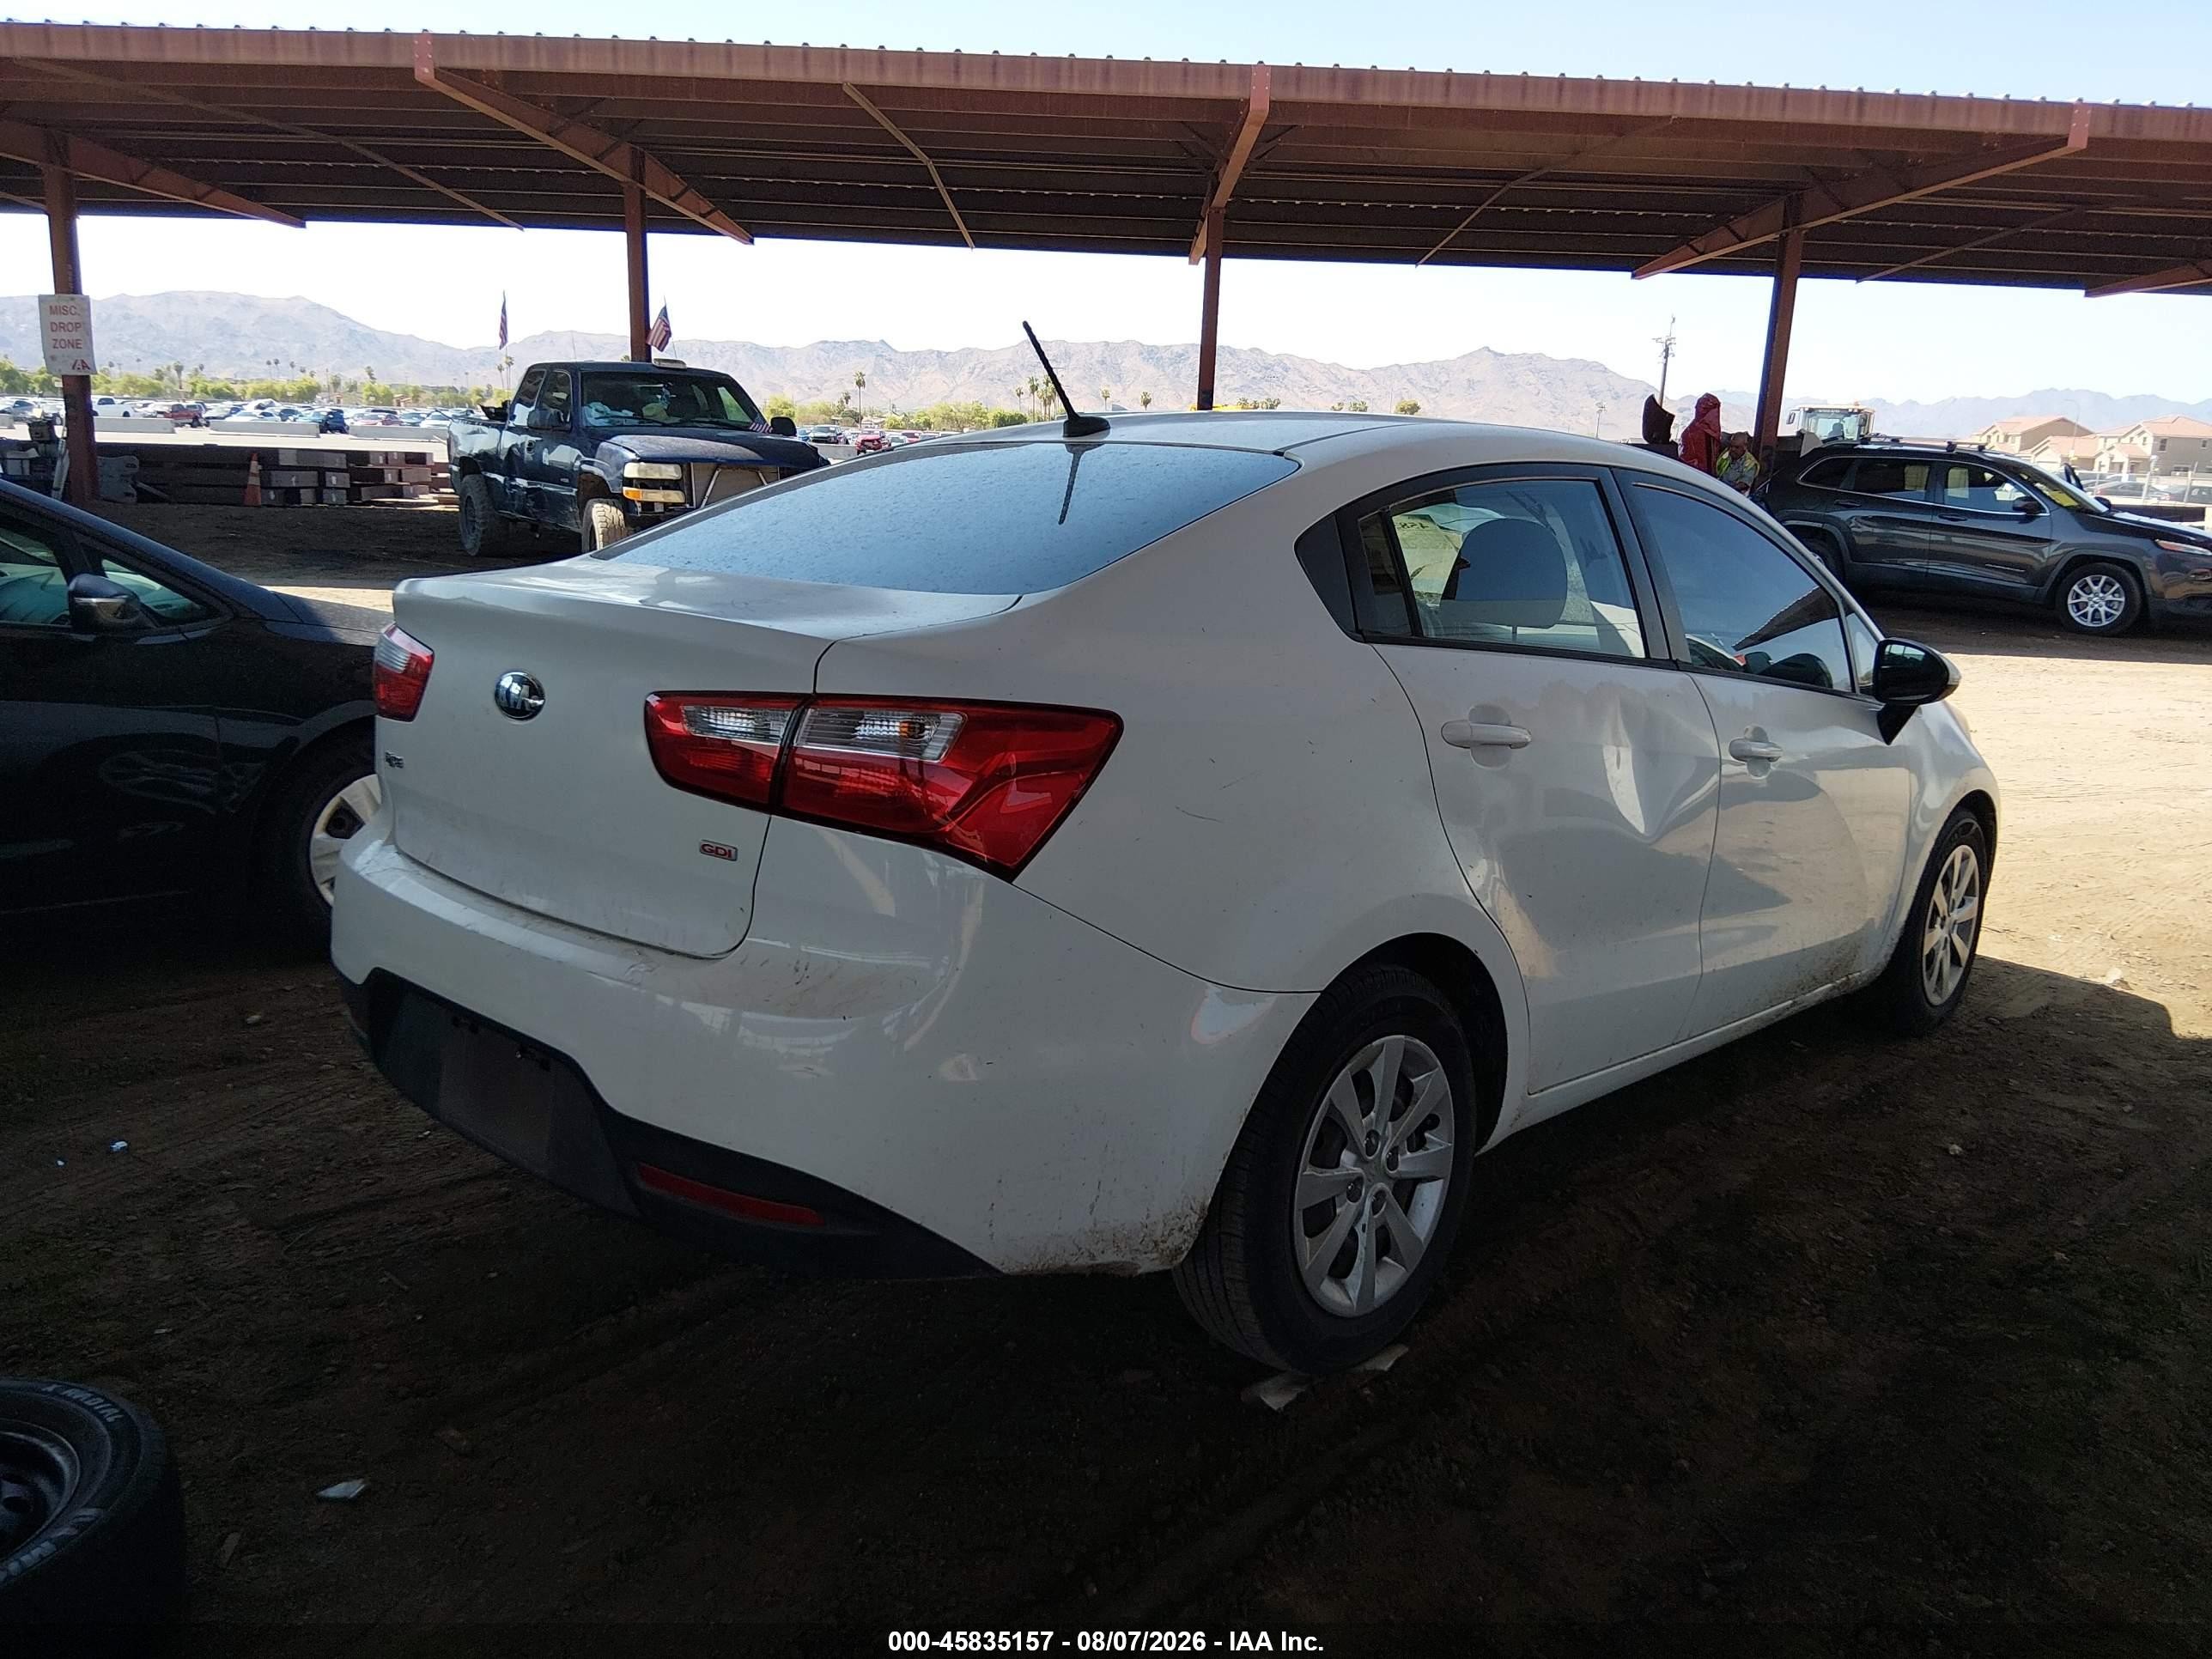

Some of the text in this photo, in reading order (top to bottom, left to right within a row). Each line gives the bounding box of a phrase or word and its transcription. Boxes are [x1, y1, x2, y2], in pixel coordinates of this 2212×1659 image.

[49, 305, 81, 316] MISC.
[50, 322, 82, 332] DROP
[52, 338, 83, 349] ZONE
[701, 843, 732, 858] GDI
